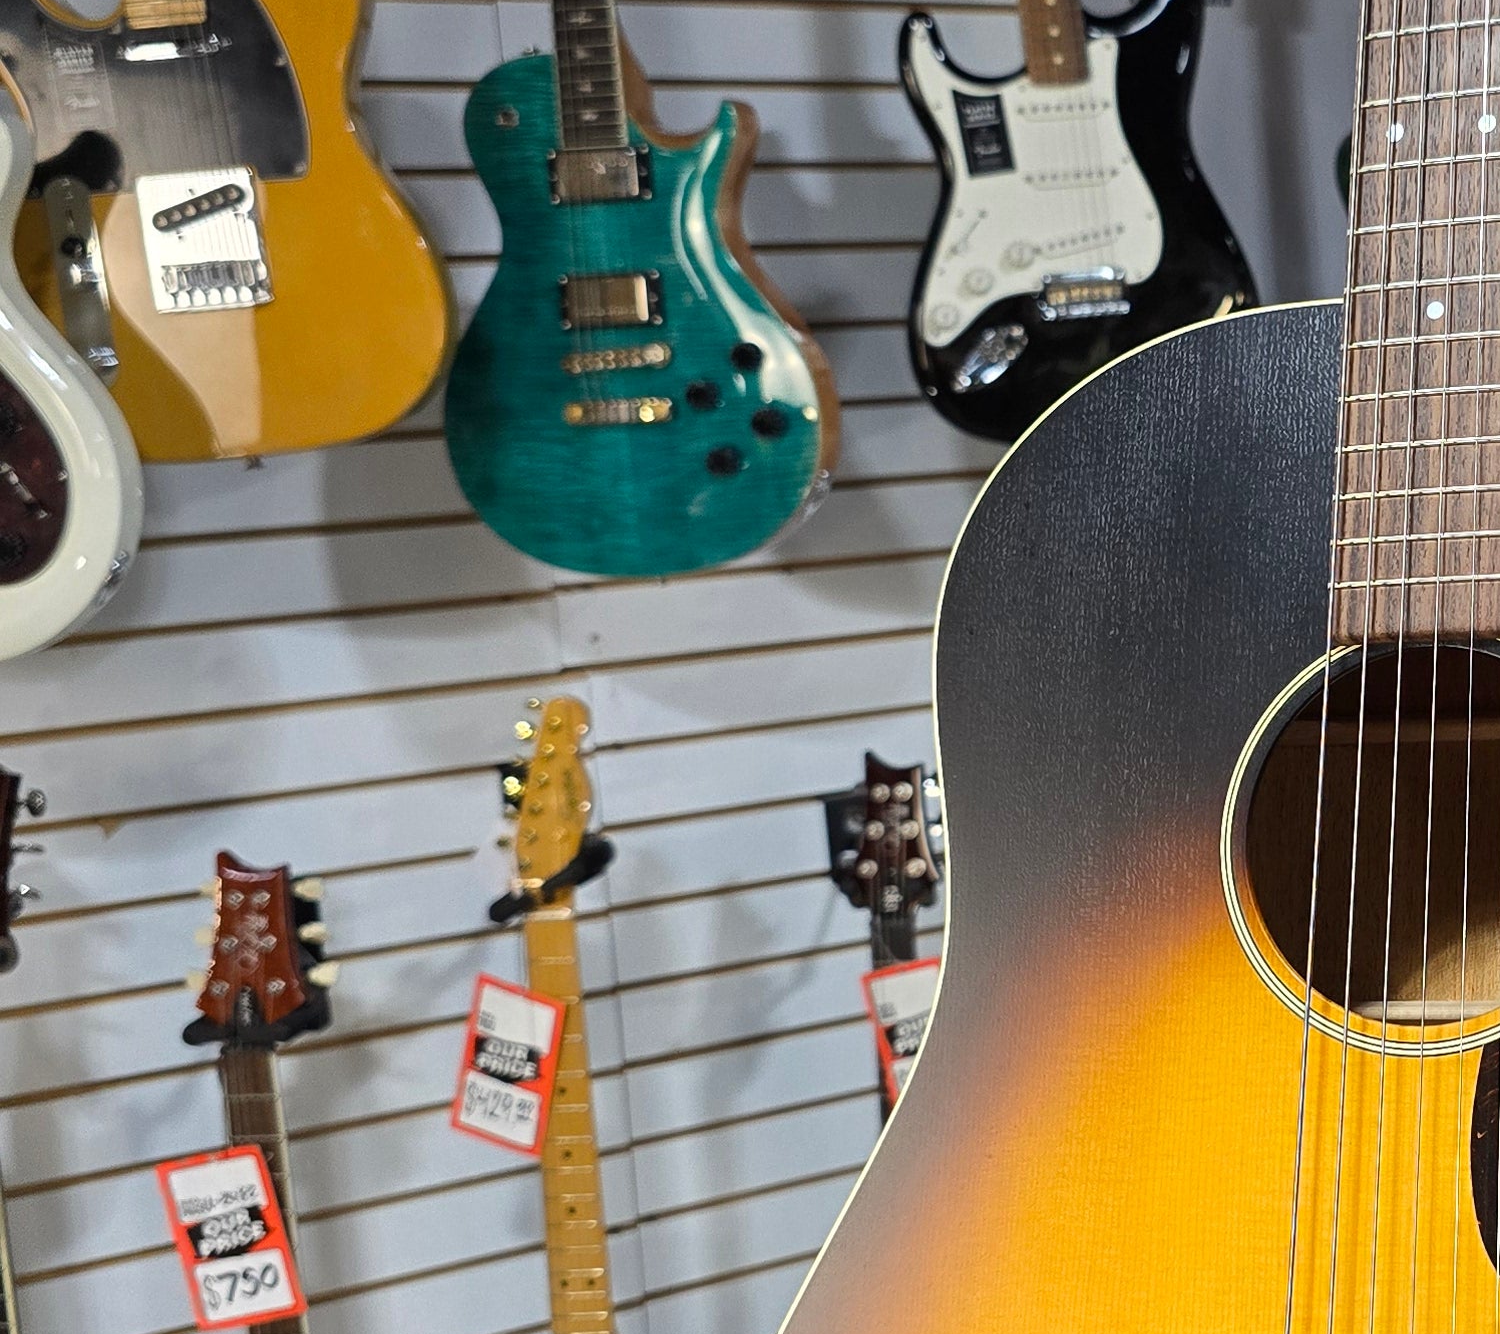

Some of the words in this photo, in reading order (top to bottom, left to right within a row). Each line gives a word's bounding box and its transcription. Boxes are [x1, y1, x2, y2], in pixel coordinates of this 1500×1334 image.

[487, 1039, 530, 1062] OUR
[476, 1051, 538, 1080] PRICE
[204, 1209, 251, 1237] OUR
[199, 1220, 267, 1259] PRICE
[204, 1263, 280, 1310] $750
